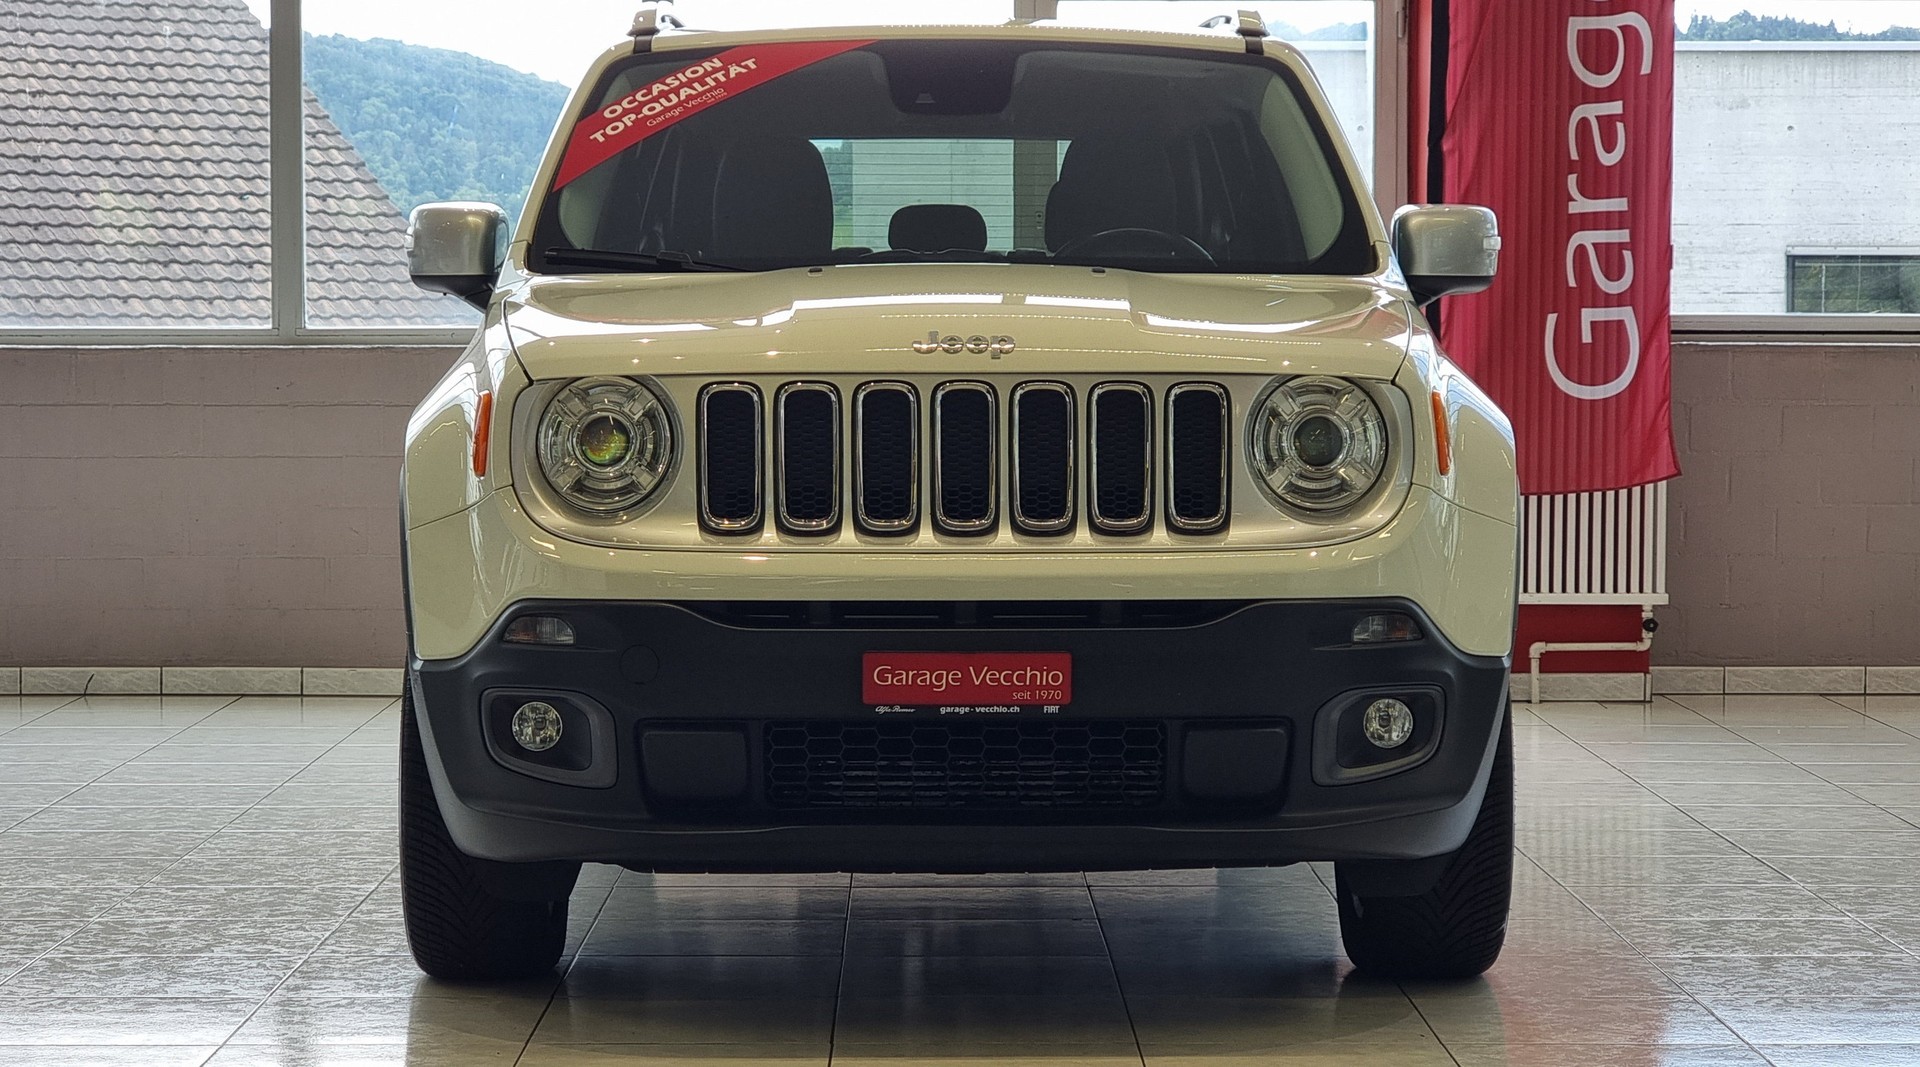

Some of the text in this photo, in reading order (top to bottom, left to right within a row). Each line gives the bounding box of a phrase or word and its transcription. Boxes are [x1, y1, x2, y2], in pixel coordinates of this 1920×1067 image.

[589, 57, 758, 143] TOP-QUALITÄT
[603, 57, 723, 119] OCCASION
[646, 105, 685, 127] Garage
[683, 88, 725, 108] Vecchio
[1545, 0, 1653, 400] Garag
[912, 330, 1016, 359] Jeep
[873, 665, 1064, 692] Garage Vecchio
[1012, 690, 1062, 700] seit 1970
[1043, 705, 1060, 714] FIAT
